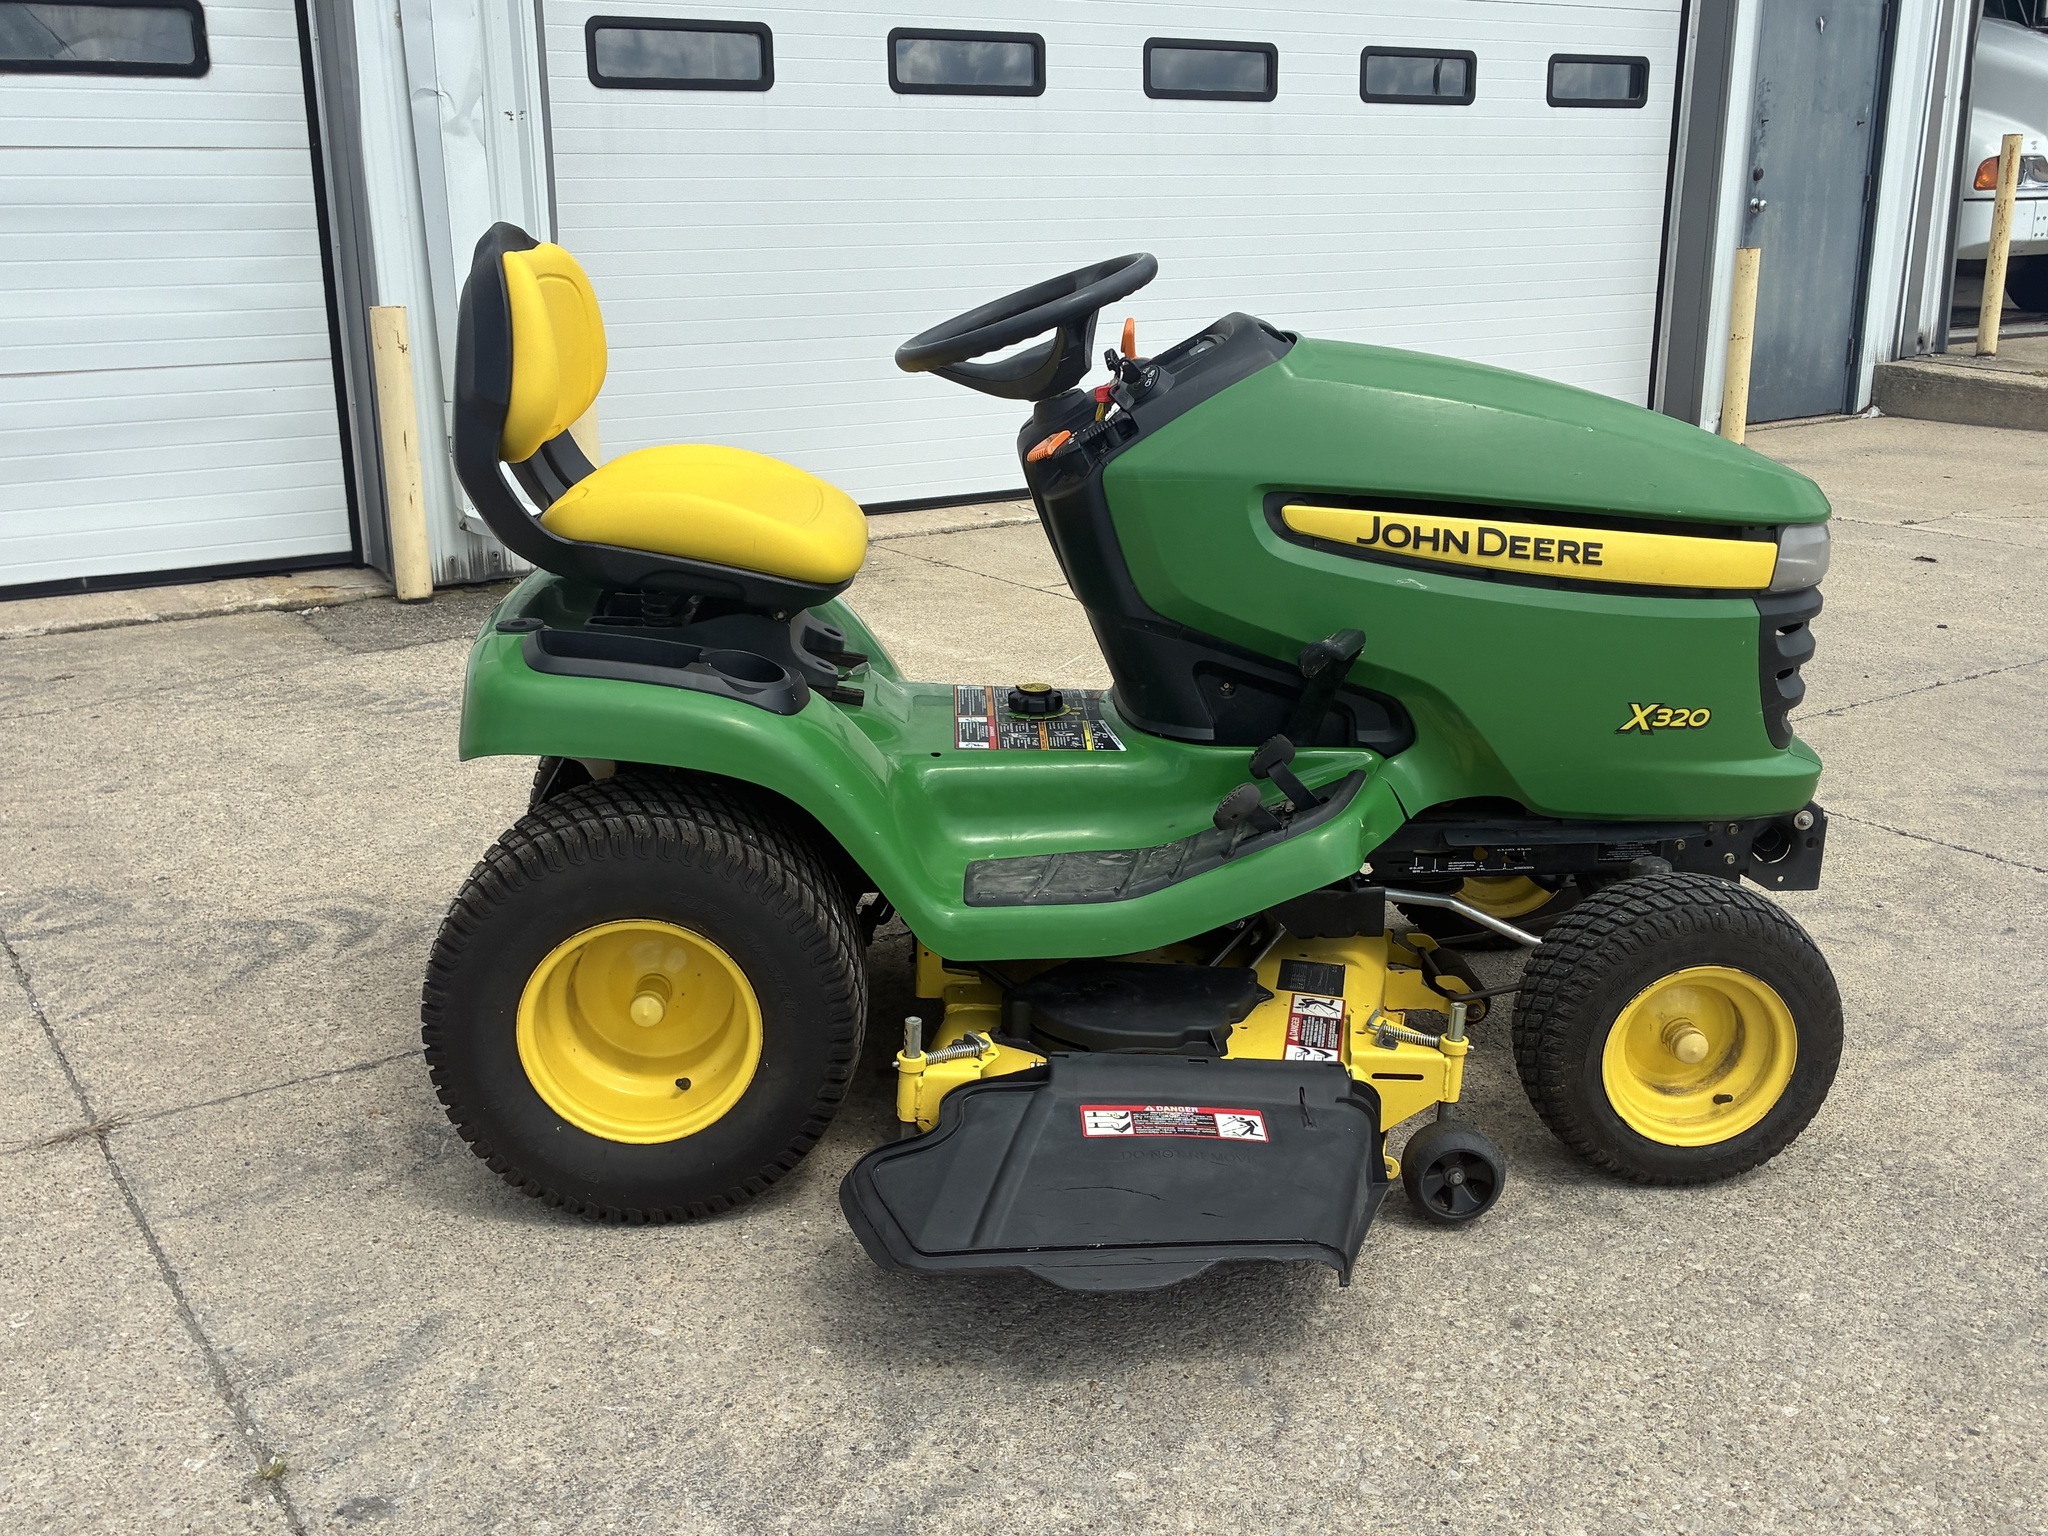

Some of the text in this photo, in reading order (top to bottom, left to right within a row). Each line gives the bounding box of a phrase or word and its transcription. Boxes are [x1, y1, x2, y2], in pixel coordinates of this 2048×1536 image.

[1357, 516, 1603, 566] JOHN DEERE
[1616, 703, 1711, 733] X320
[1289, 1017, 1300, 1036] DANGER
[1155, 1105, 1199, 1113] DANGER
[1121, 1150, 1145, 1160] DO
[1150, 1149, 1181, 1161] NOT
